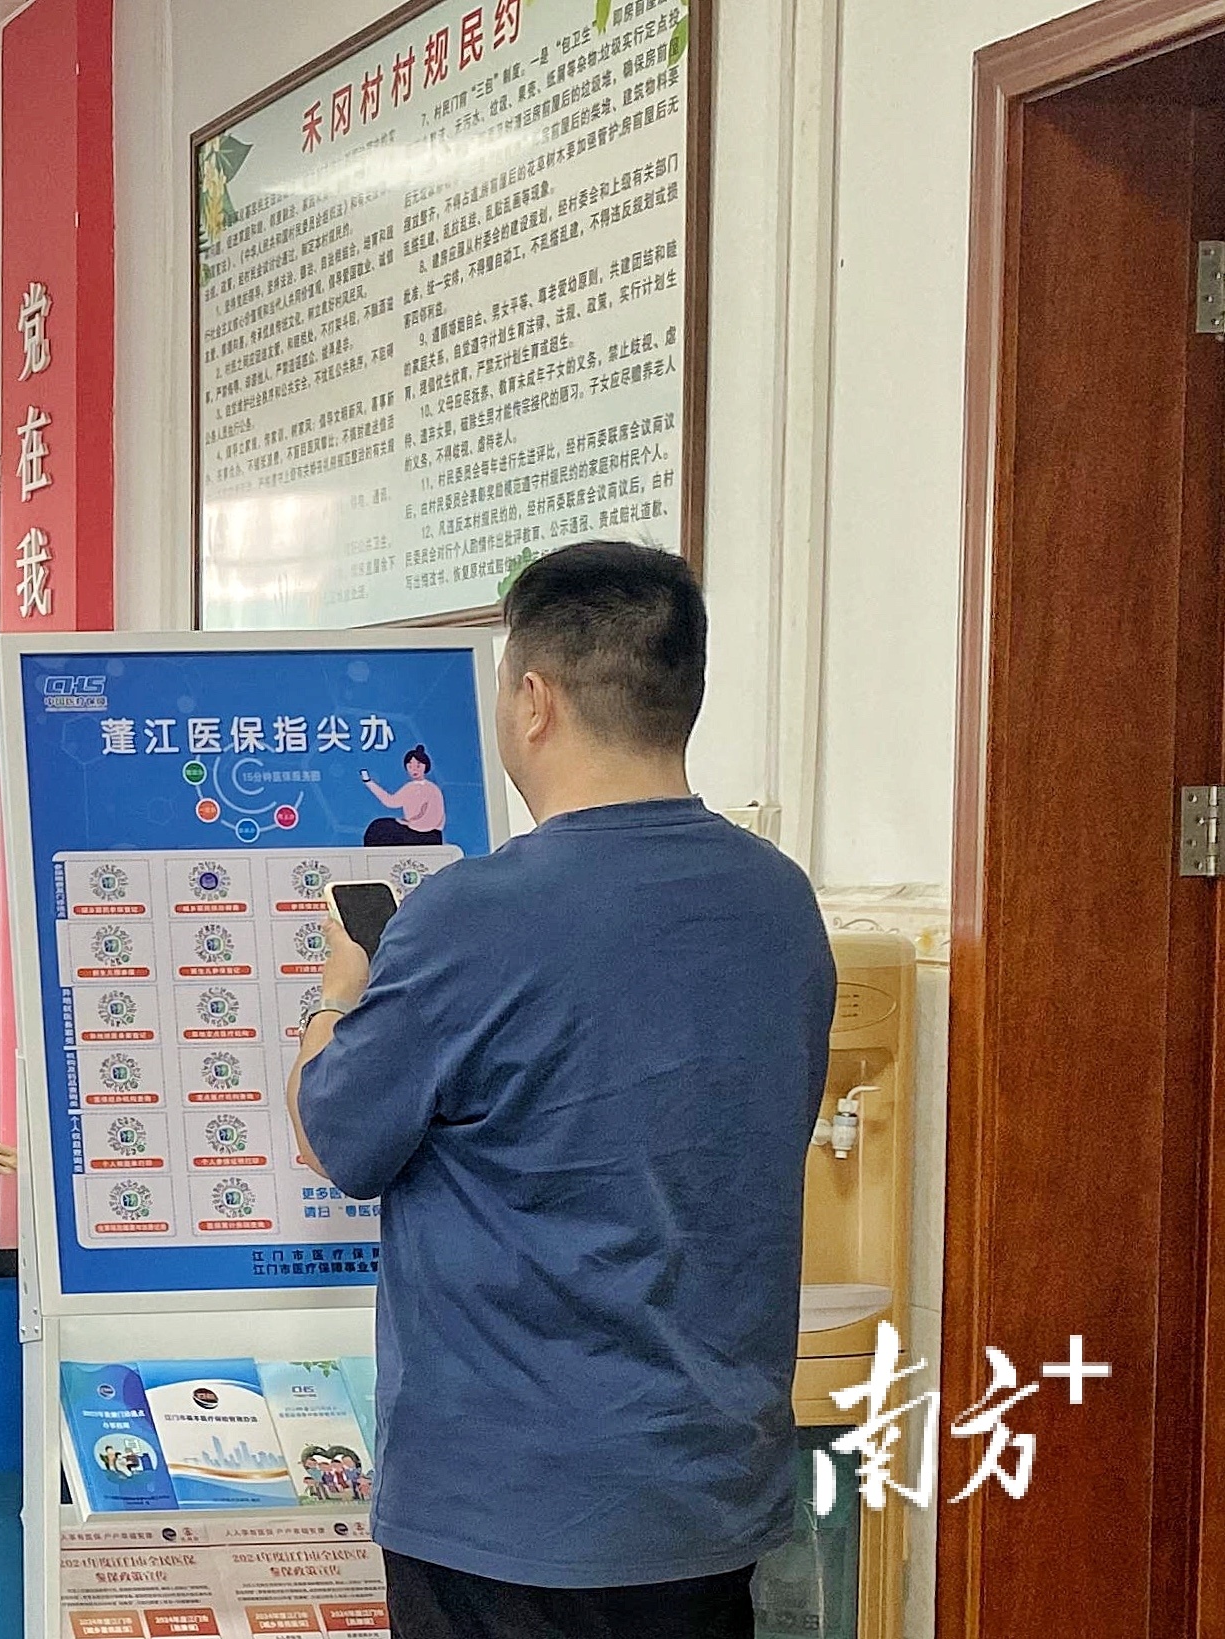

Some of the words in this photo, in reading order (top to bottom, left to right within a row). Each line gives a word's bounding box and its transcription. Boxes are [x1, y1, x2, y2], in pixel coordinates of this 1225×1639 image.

[301, 0, 522, 153] 禾冈村村规民约
[17, 282, 52, 617] 党在我
[99, 714, 396, 756] 蓬江医保指尖办
[302, 1187, 346, 1200] 更多医
